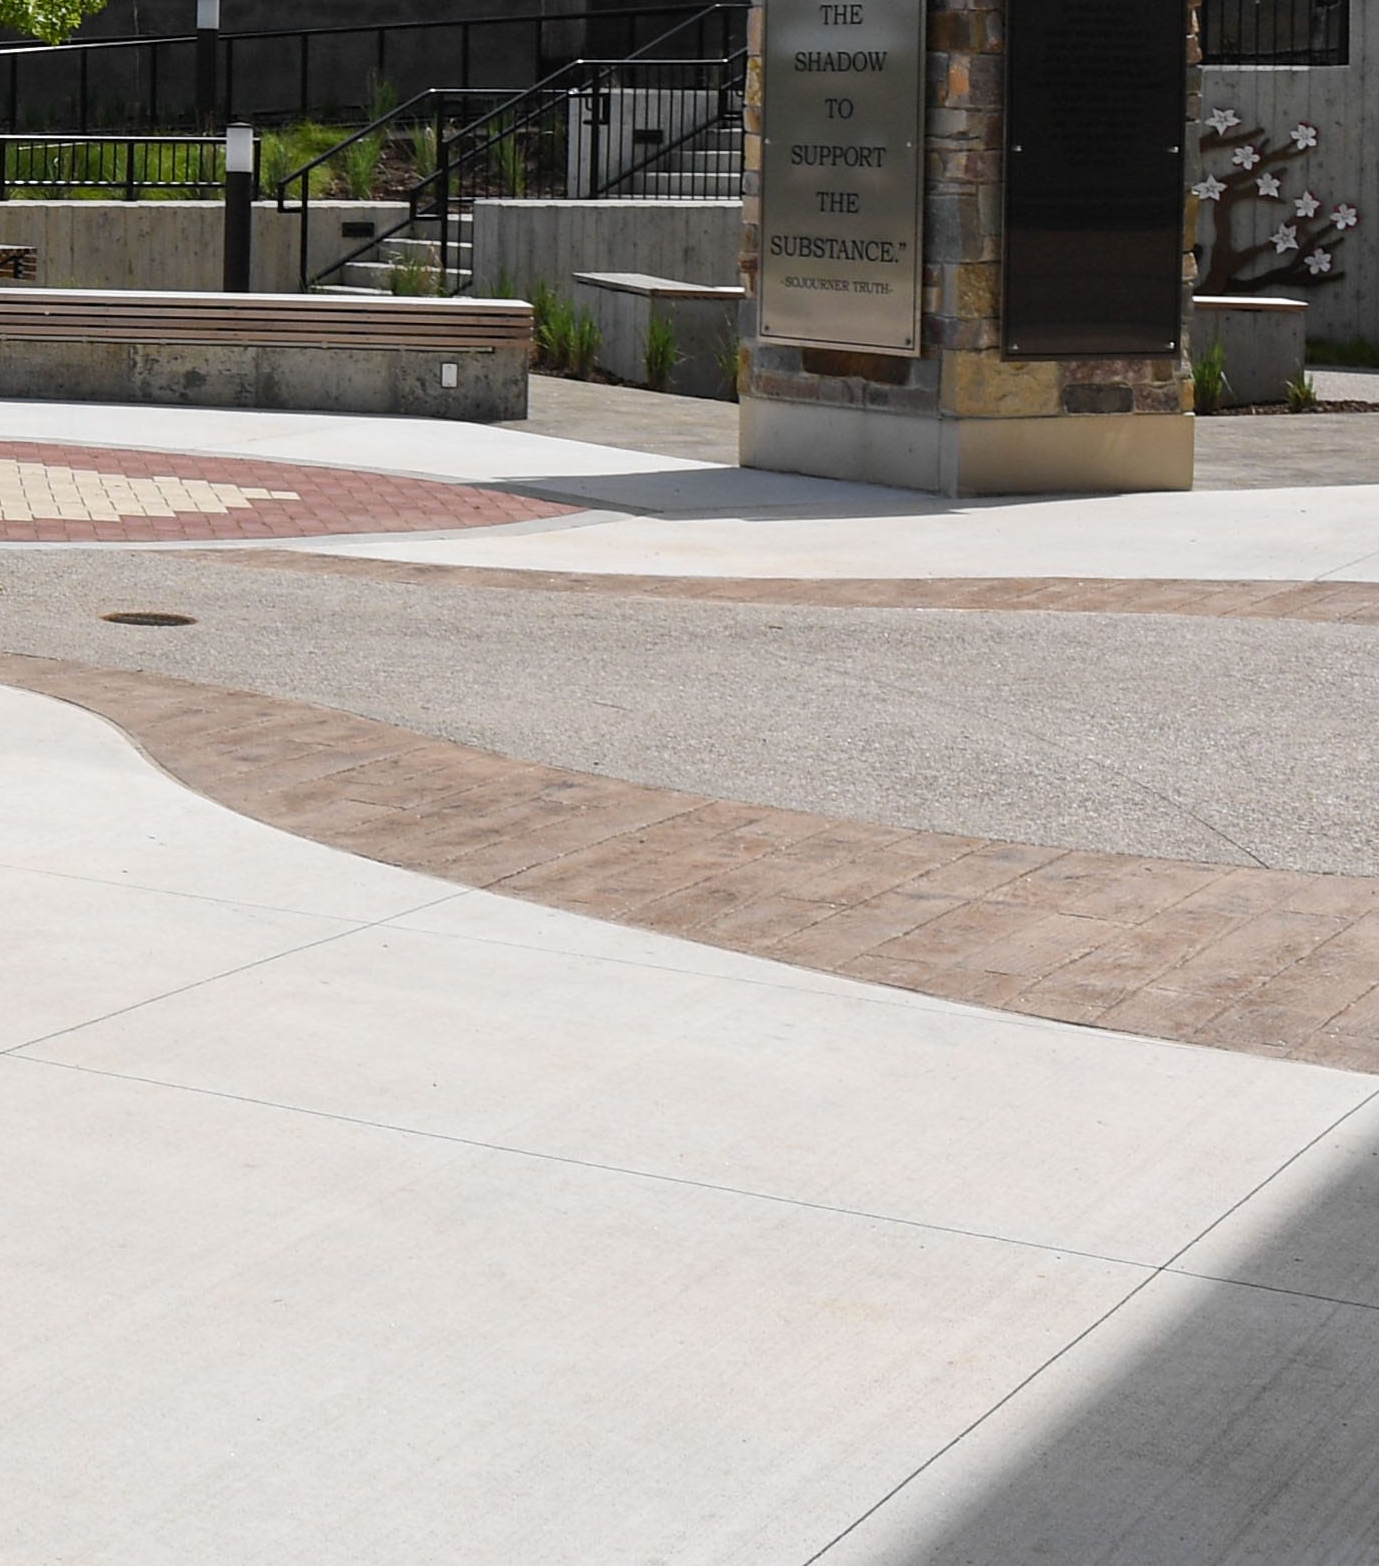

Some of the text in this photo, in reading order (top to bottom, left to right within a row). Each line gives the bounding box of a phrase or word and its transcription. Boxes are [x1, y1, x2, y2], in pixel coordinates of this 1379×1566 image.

[820, 4, 864, 25] THE
[794, 50, 888, 72] SHADOW
[825, 98, 854, 120] TO
[791, 144, 886, 168] SUPPORT
[816, 191, 860, 214] THE
[770, 235, 907, 263] SUBSTANCE.”
[781, 275, 894, 295] -SOJOURNER TRUTH-
